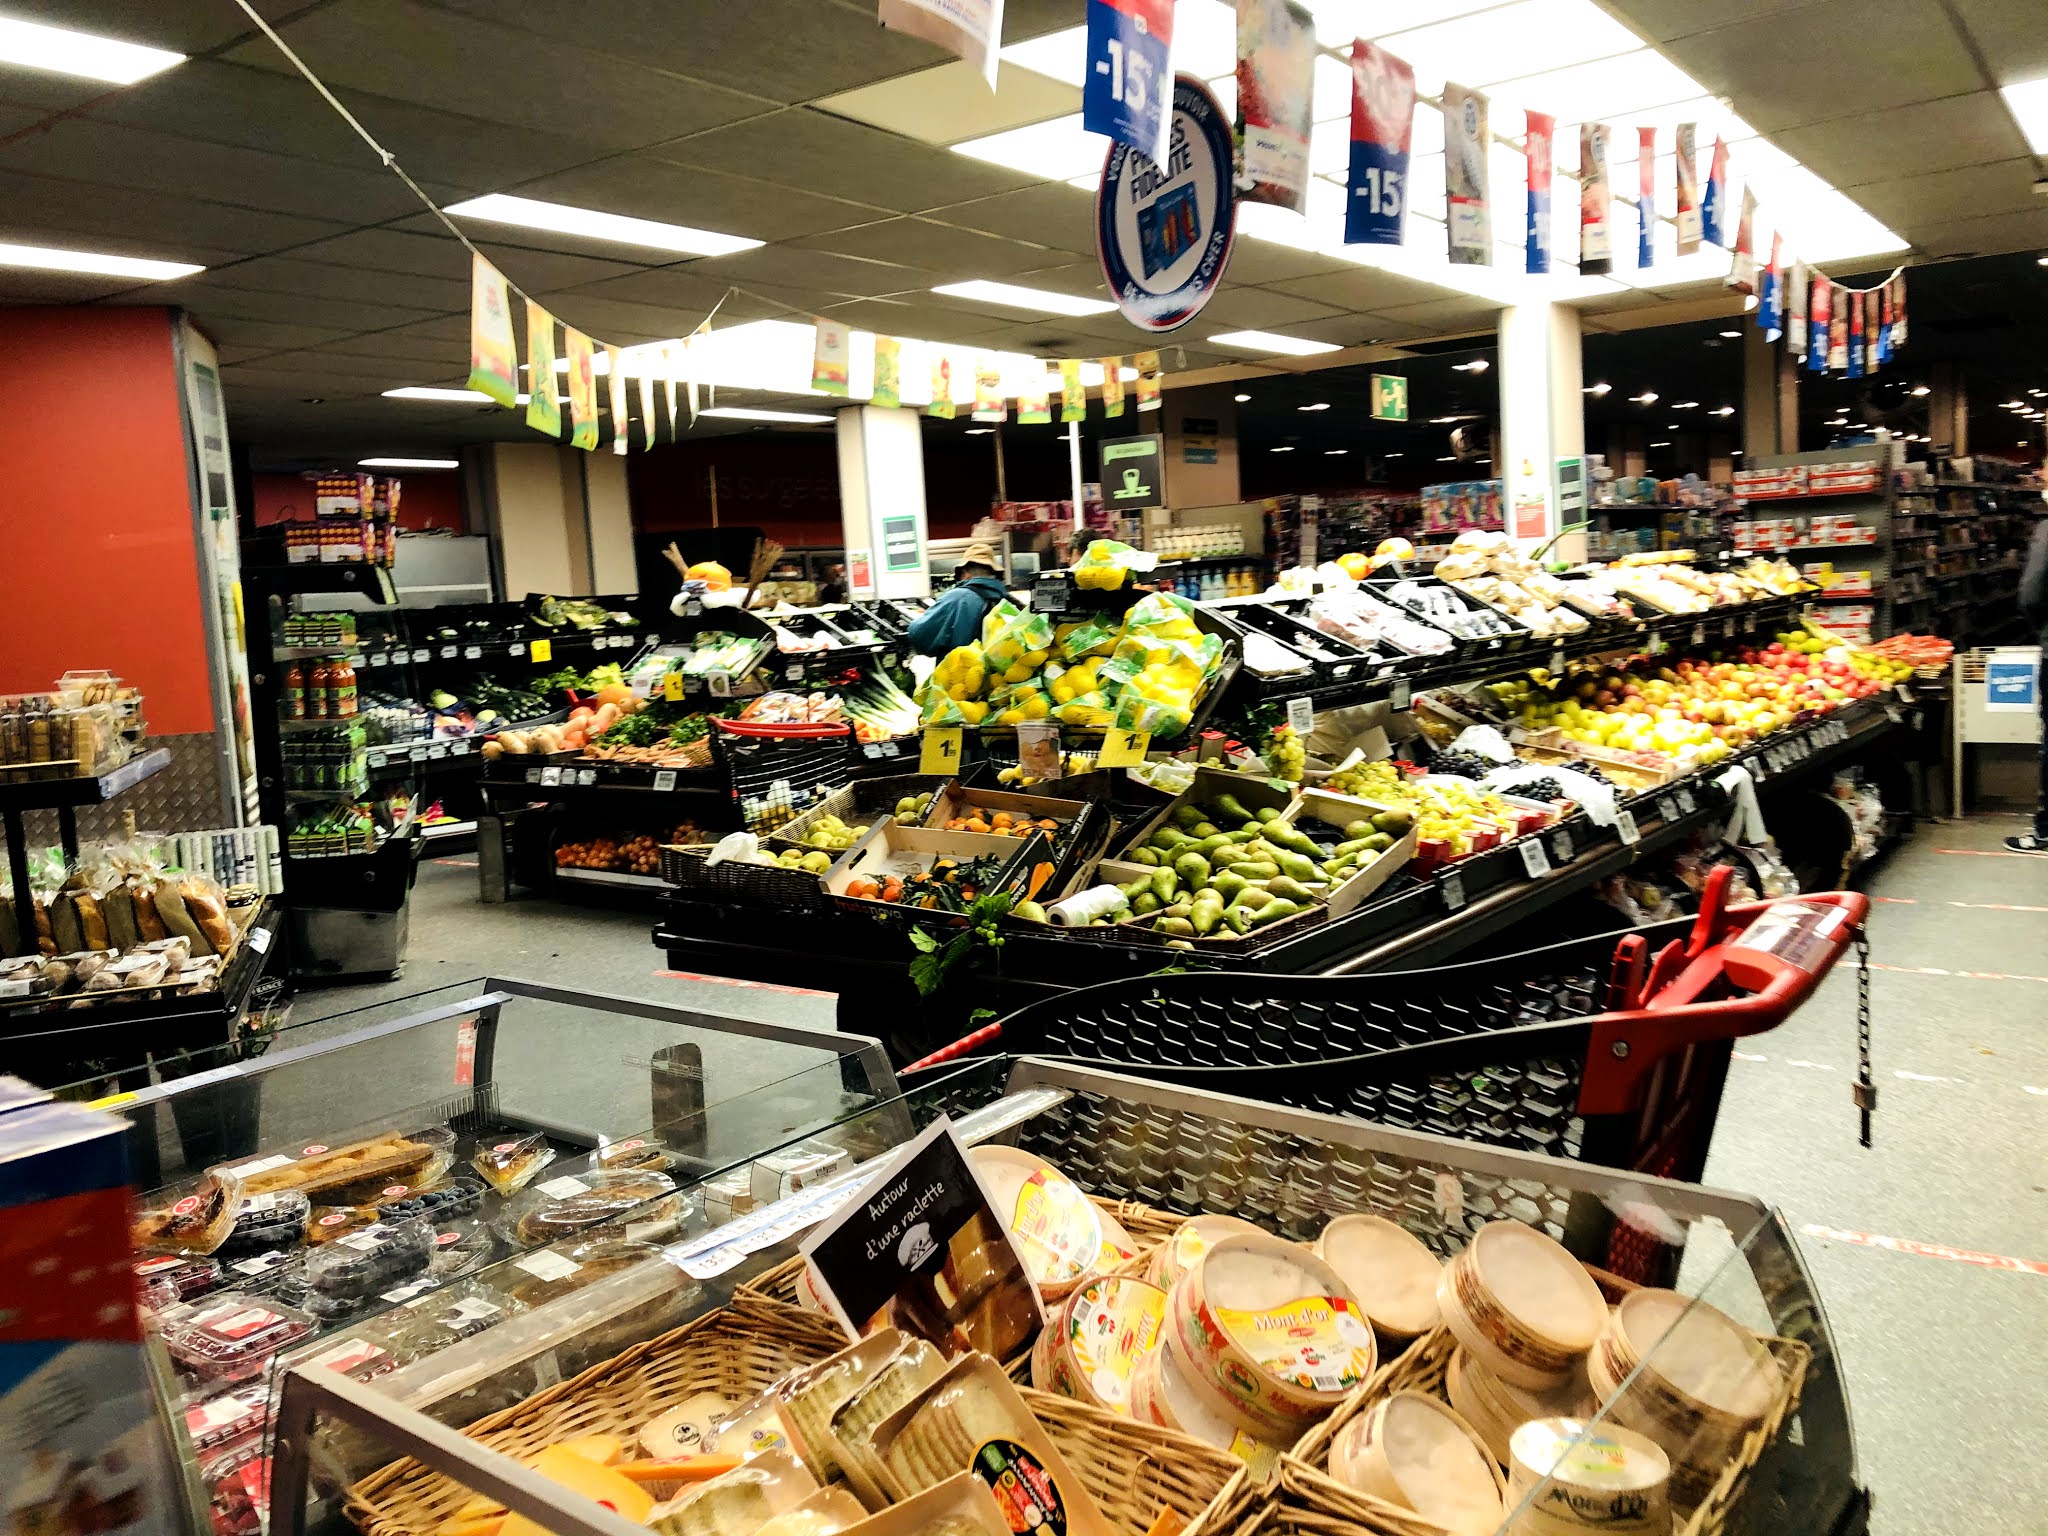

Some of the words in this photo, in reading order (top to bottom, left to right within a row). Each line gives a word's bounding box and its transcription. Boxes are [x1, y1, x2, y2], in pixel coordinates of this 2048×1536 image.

[866, 1224, 901, 1261] d'une
[901, 1181, 945, 1228] raclette
[869, 1177, 910, 1222] Autour
[1135, 1310, 1157, 1355] Mont
[1253, 1311, 1297, 1331] Mont
[1300, 1307, 1330, 1324] d'or
